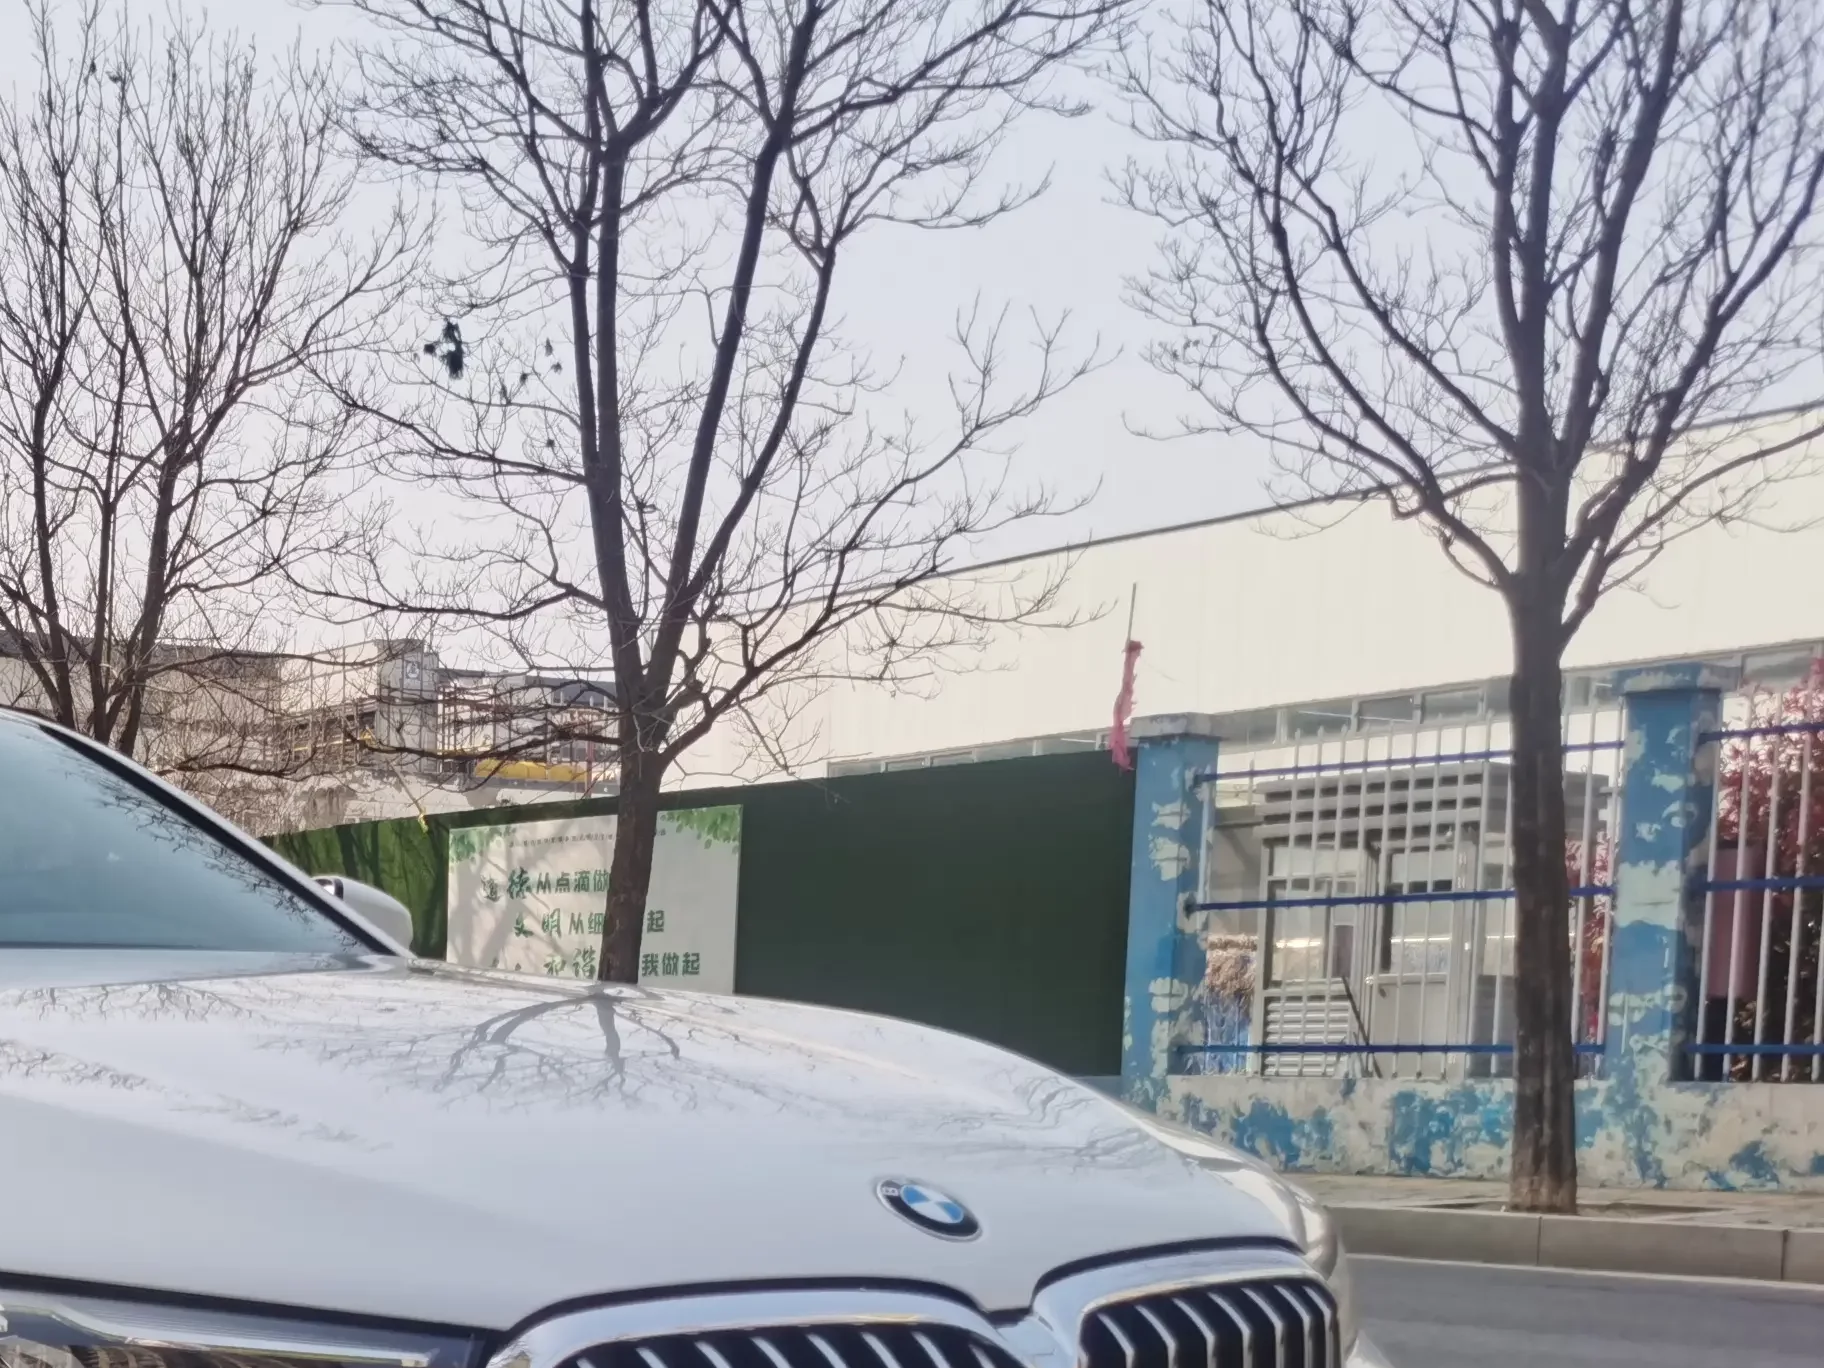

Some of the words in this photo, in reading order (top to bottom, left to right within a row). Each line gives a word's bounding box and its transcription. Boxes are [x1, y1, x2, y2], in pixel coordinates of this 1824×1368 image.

[514, 908, 664, 937] 文明从细起
[543, 945, 700, 977] 和谐我做起
